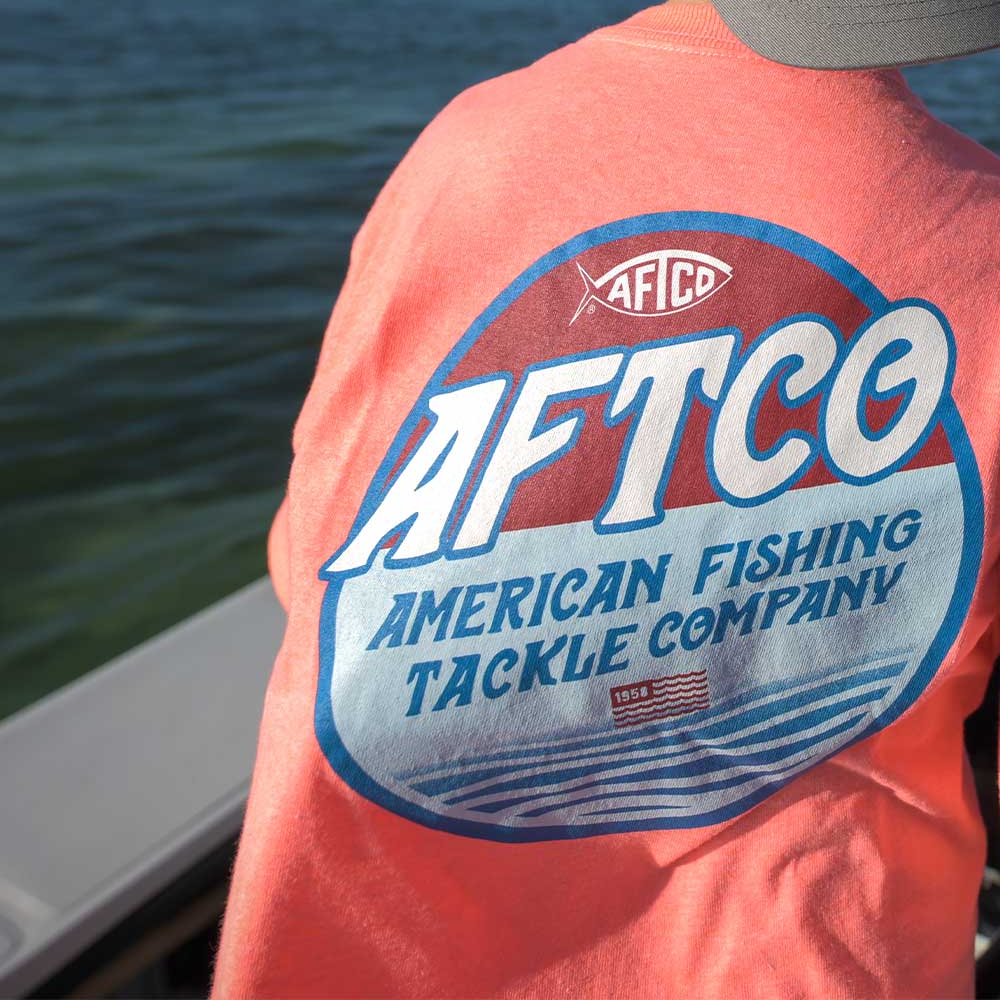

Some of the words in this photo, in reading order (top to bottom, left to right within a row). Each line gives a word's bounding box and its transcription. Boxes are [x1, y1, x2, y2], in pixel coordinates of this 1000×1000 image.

[606, 250, 715, 311] AFTCO
[322, 302, 952, 576] AFTCO
[365, 552, 673, 651] AMERICAN
[691, 508, 923, 597] FISHING
[404, 623, 639, 717] TACKLE
[647, 561, 908, 658] COMPANY
